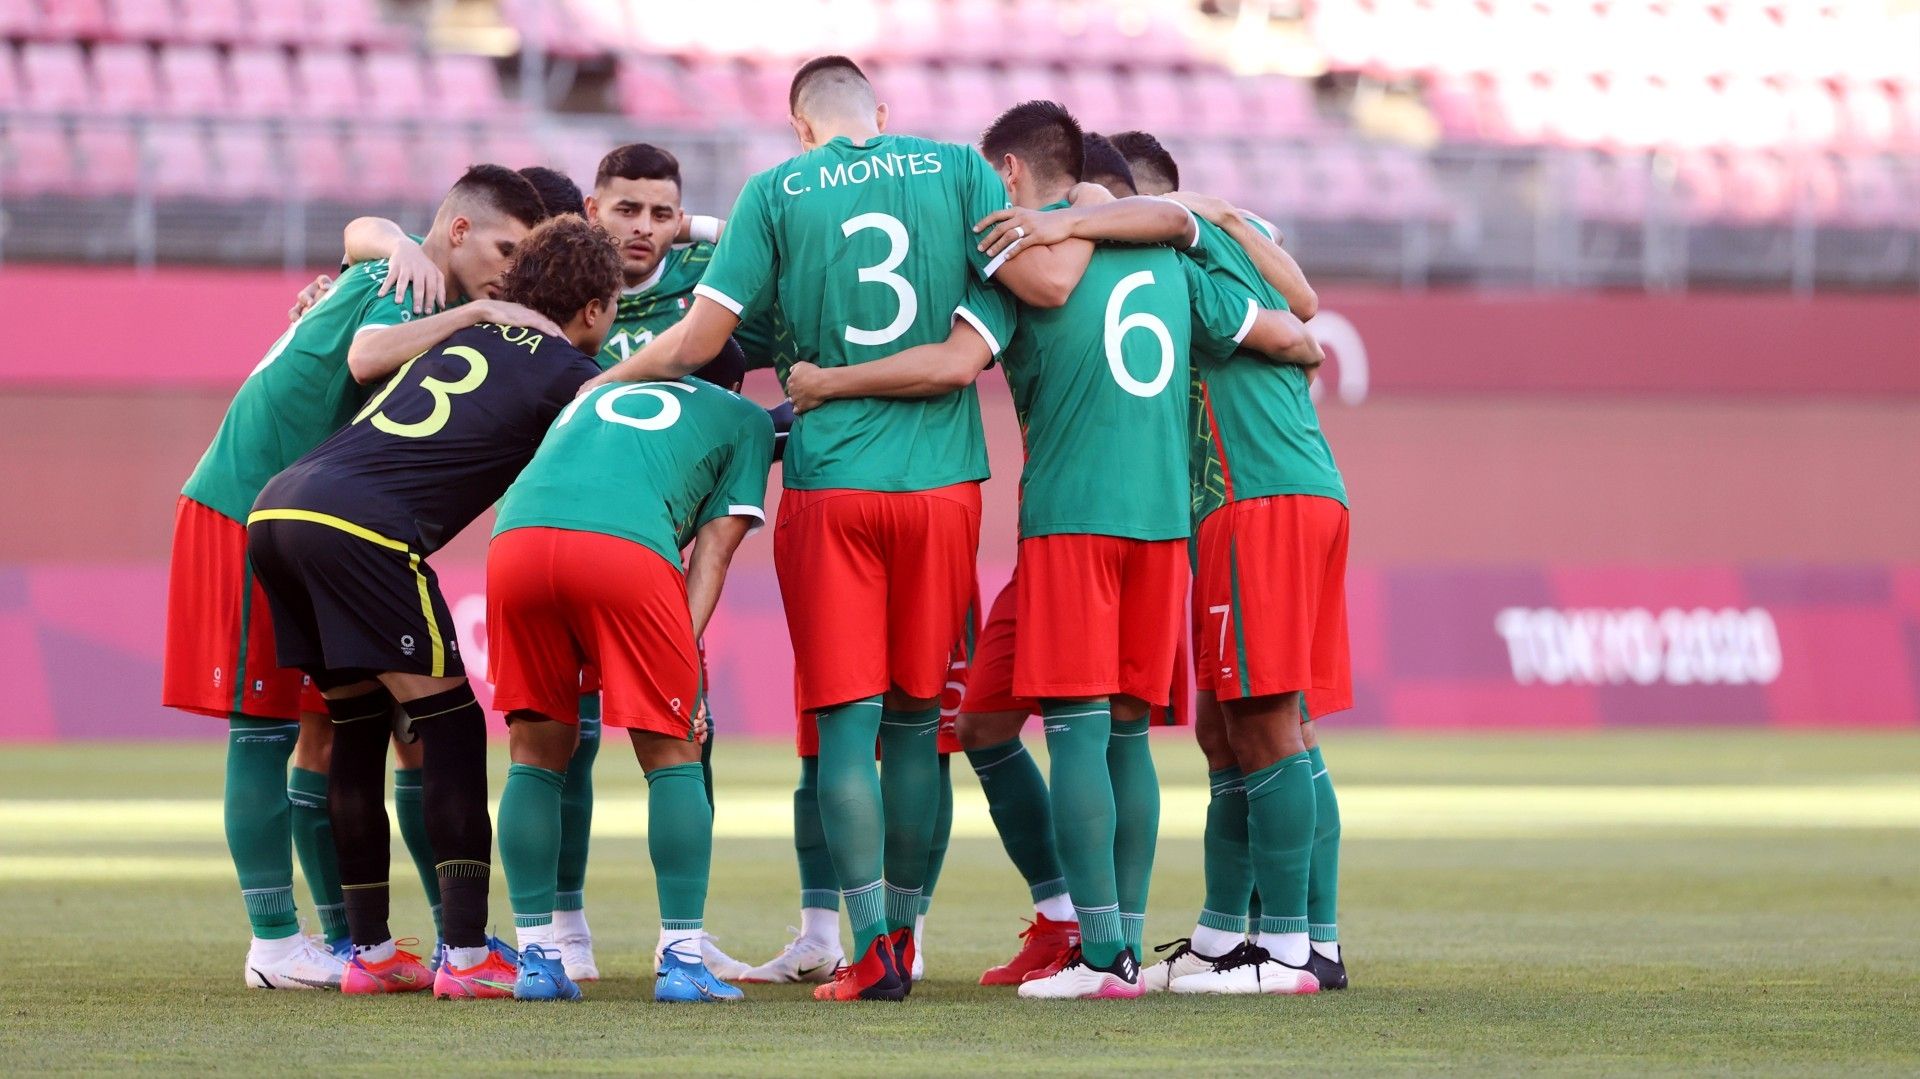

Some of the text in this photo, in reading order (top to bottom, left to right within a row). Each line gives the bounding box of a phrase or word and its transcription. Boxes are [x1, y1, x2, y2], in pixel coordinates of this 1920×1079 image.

[783, 152, 942, 196] C. MONTES
[840, 212, 918, 346] 3
[1103, 270, 1175, 398] 6
[351, 345, 489, 438] 13
[1209, 604, 1230, 661] 7
[1495, 607, 1783, 685] TOKYO 2020
